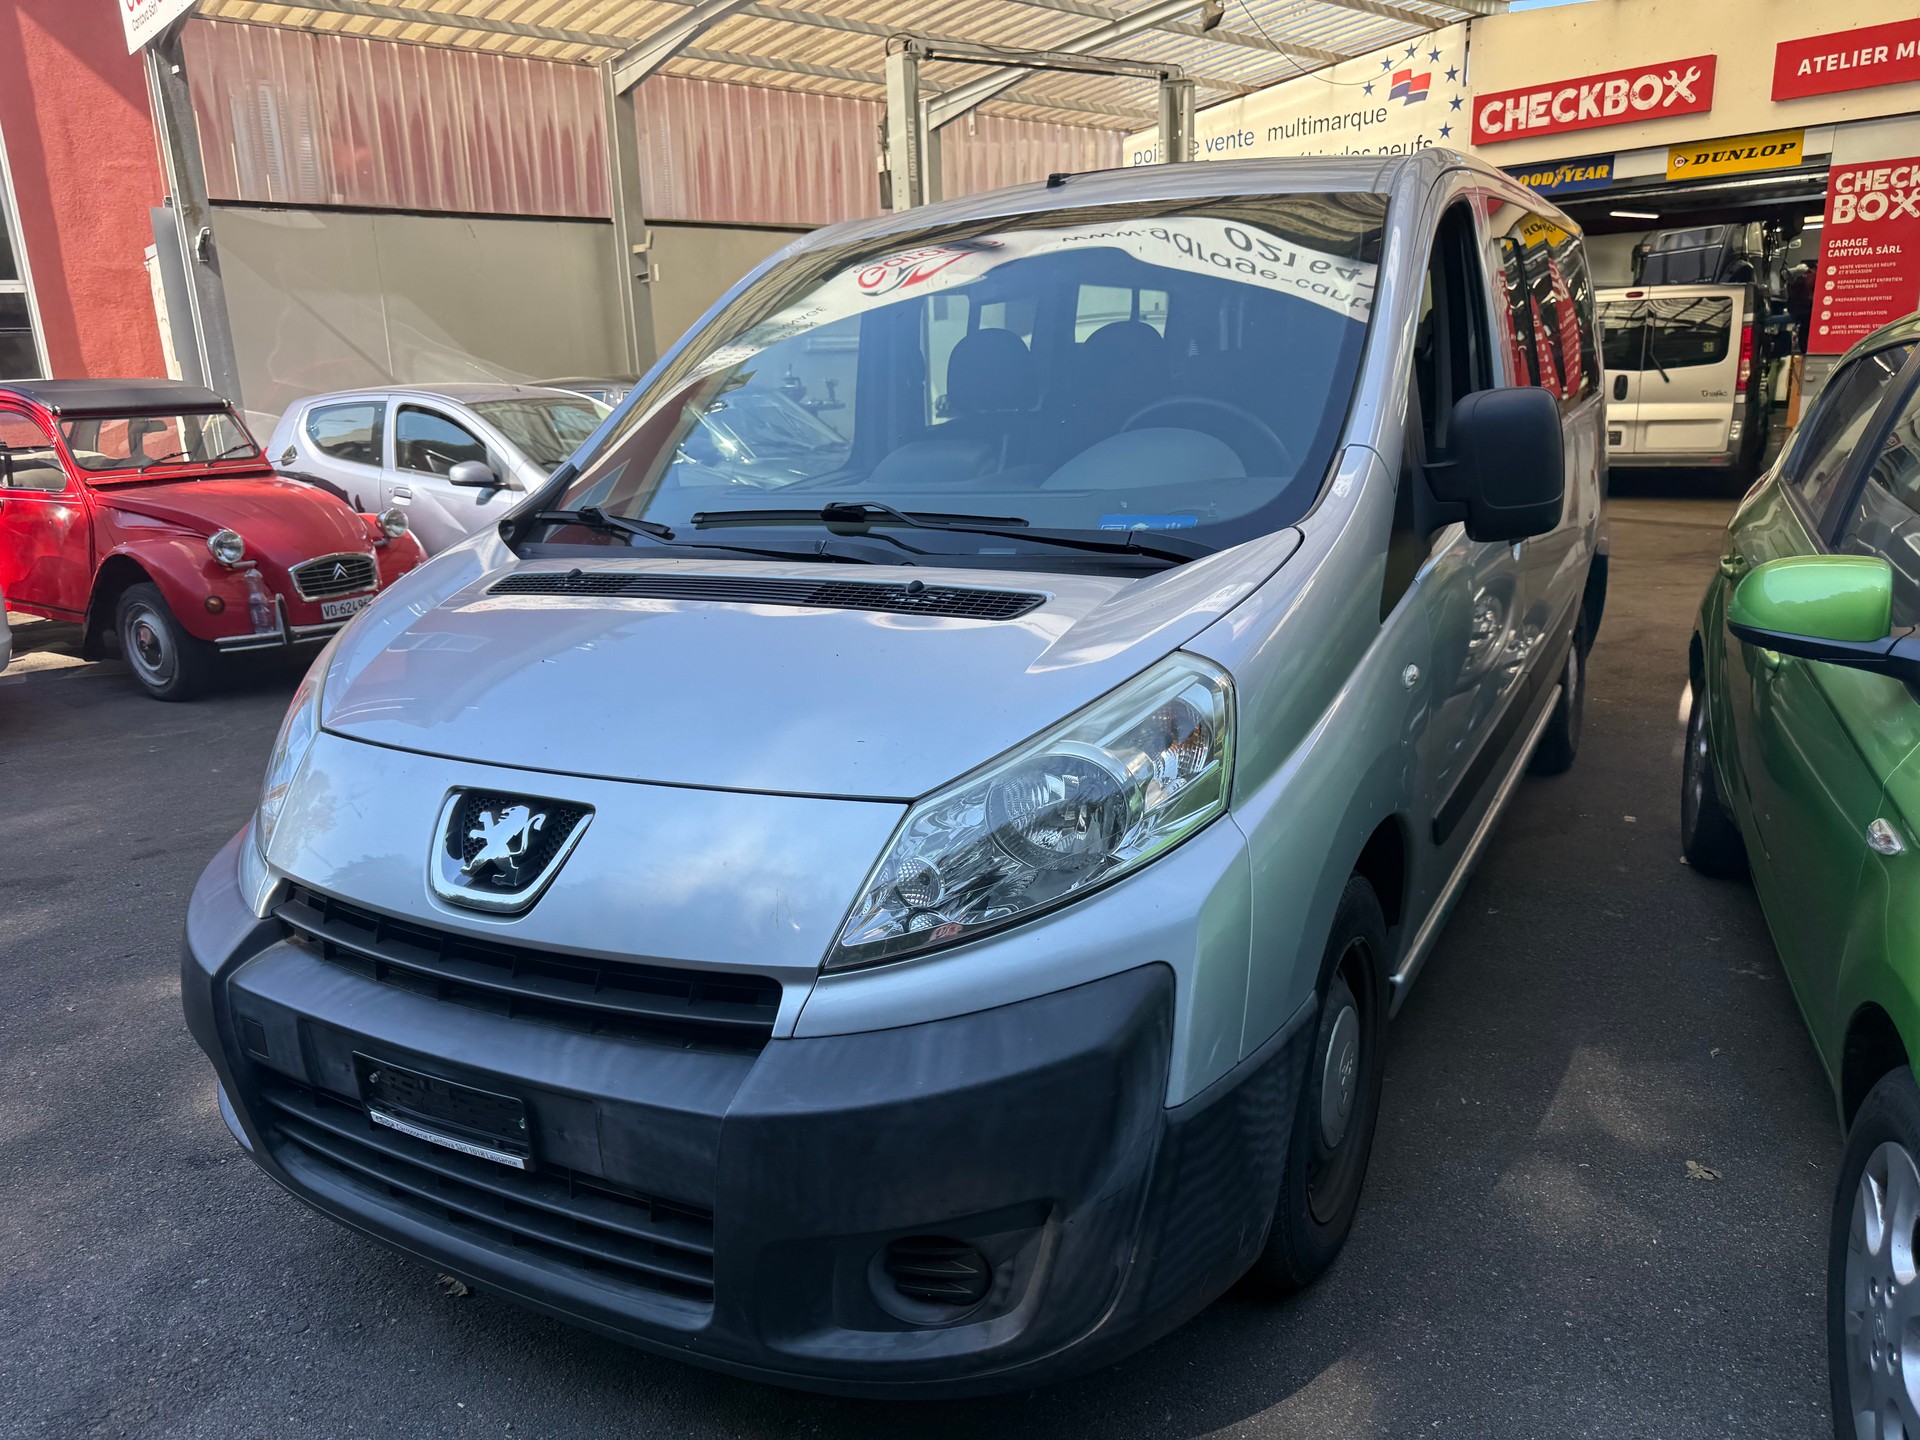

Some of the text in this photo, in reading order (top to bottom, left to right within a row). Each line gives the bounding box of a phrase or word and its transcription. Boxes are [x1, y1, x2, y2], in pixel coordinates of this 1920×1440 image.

[1797, 46, 1888, 76] ATELIER
[1479, 66, 1701, 135] CHECKBOX
[1205, 129, 1255, 153] vente
[1268, 107, 1388, 142] multimarque
[1692, 142, 1796, 165] DUNLOP
[1518, 164, 1609, 188] OODYEAR
[1831, 187, 1920, 224] BOX
[1827, 246, 1873, 258] CANTOVA
[1828, 237, 1869, 248] GARAGE
